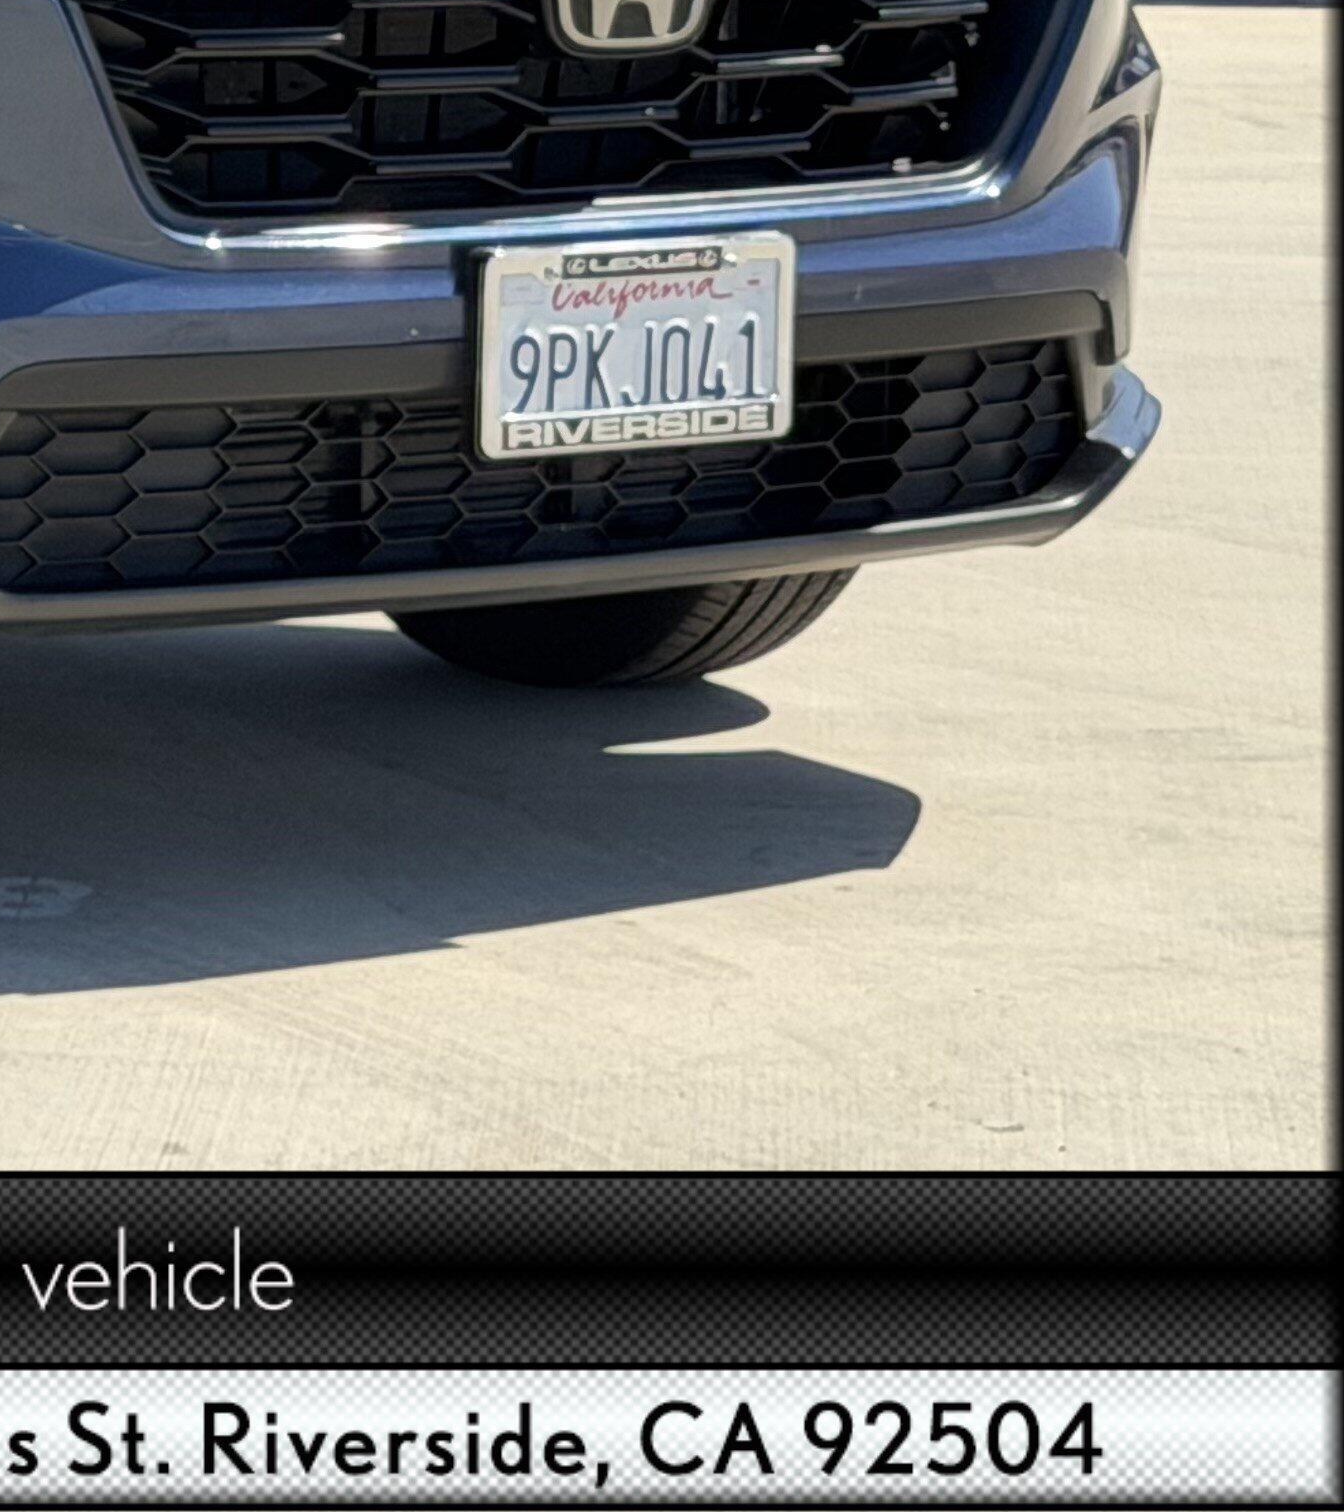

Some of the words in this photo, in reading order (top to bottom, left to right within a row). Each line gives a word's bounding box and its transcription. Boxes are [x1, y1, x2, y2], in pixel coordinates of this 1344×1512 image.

[588, 251, 699, 273] LEXUS
[552, 276, 733, 318] California
[510, 317, 764, 414] 9PKJ041
[508, 405, 768, 449] RIVERSIDE
